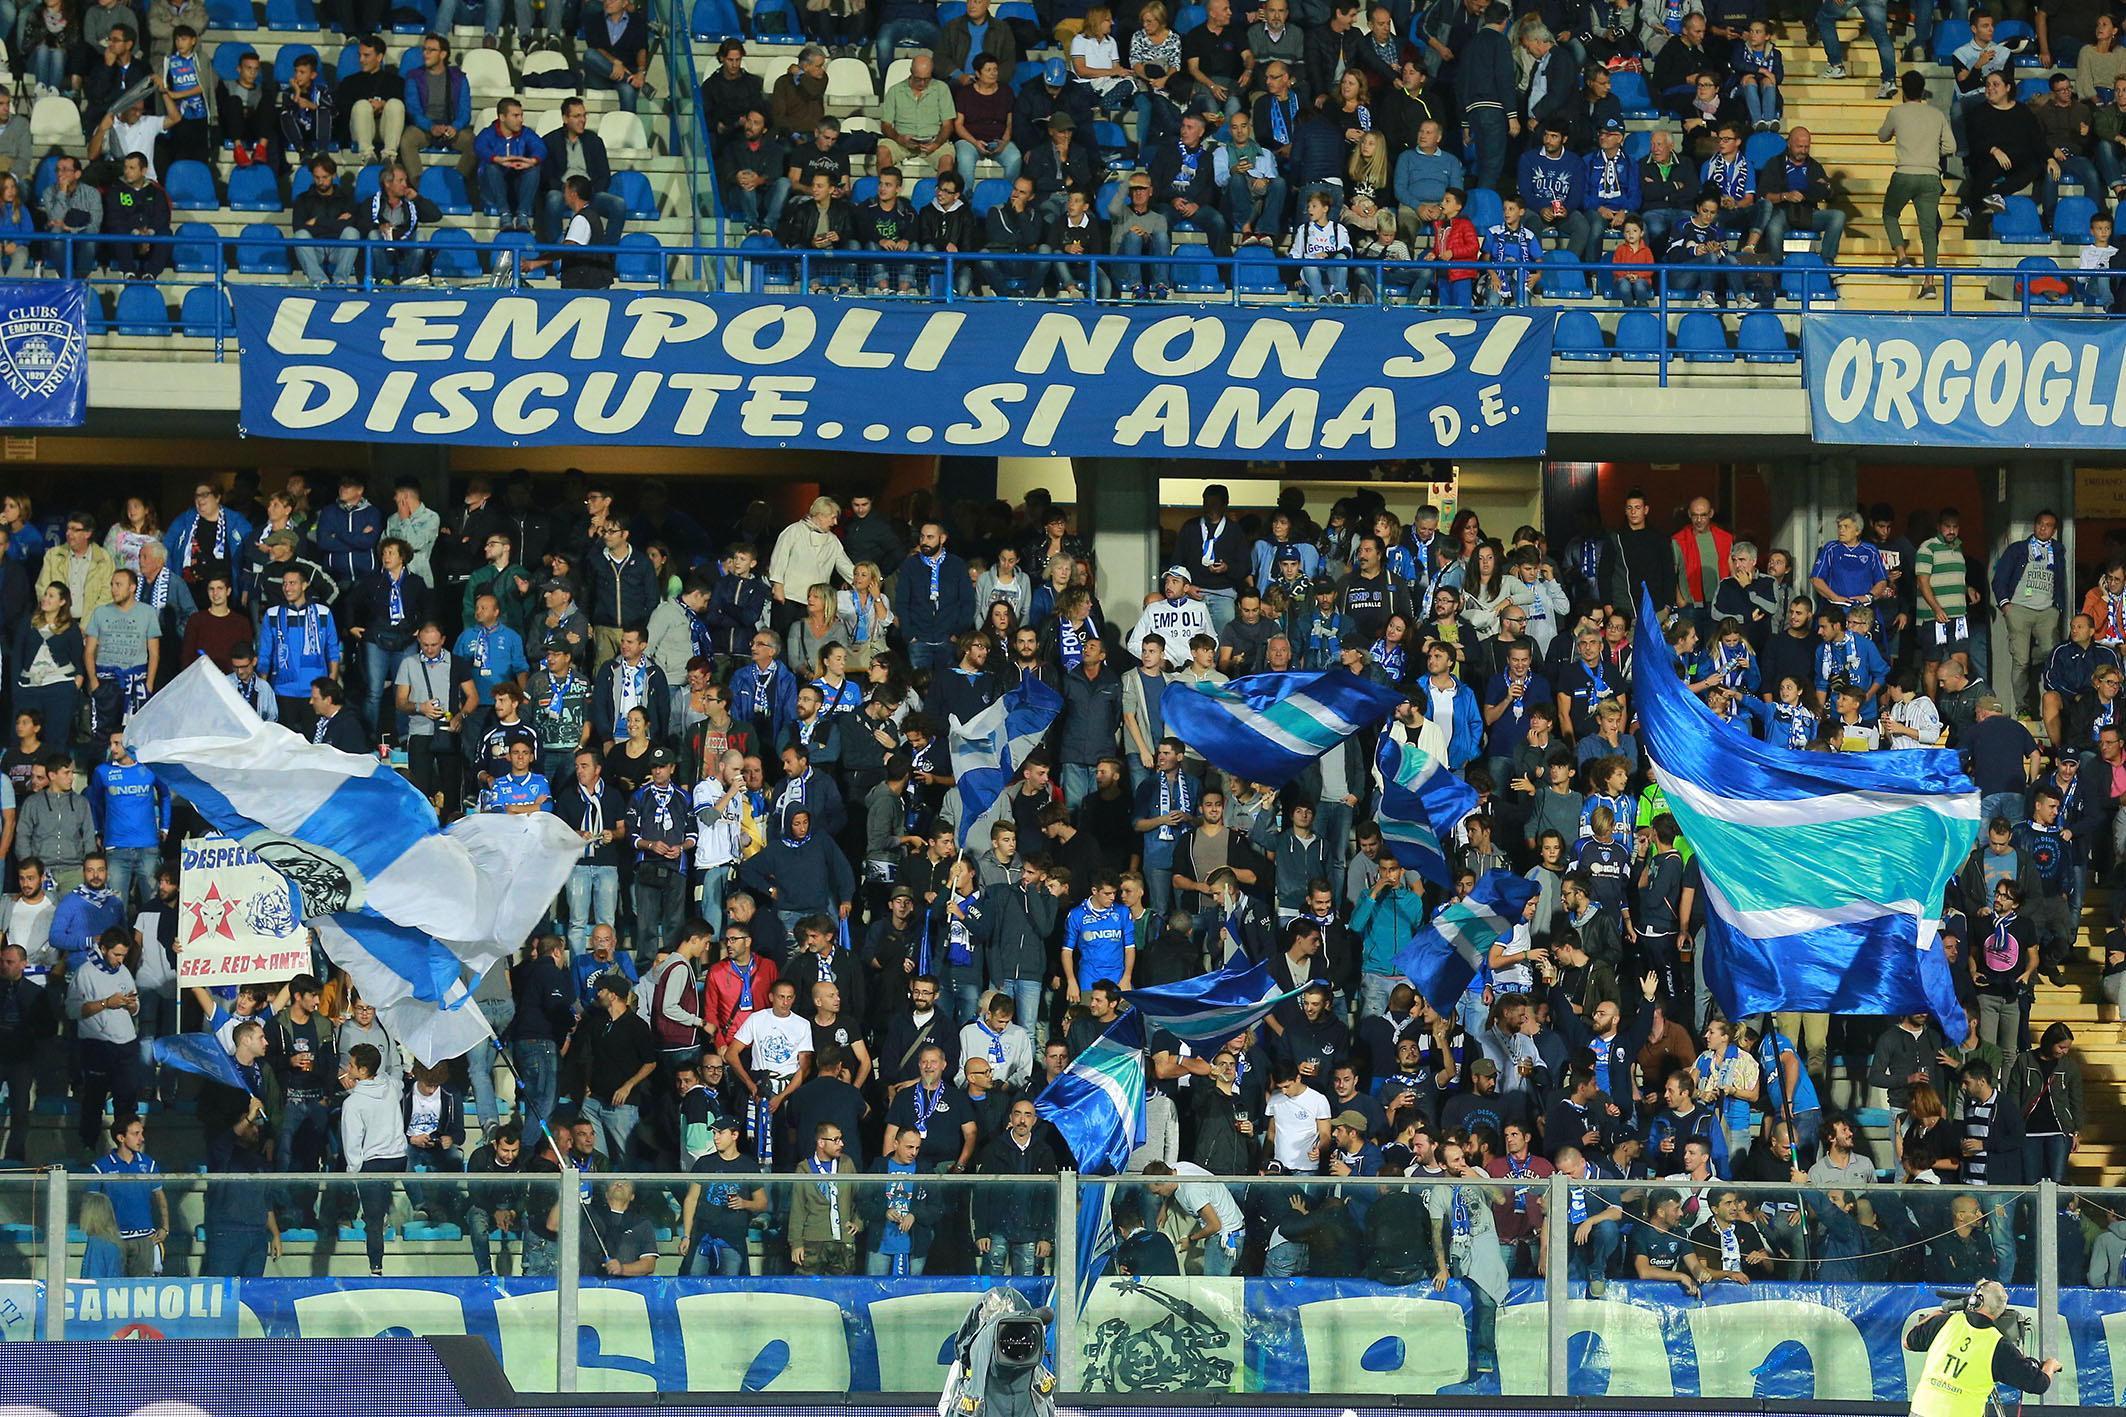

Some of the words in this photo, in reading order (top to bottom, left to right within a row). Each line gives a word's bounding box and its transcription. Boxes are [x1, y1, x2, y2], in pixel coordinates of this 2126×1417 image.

[8, 306, 59, 321] CLUBS
[8, 321, 46, 335] EMPOLI
[267, 296, 967, 373] L'EMPOLI
[1014, 311, 1345, 380] NON
[1383, 315, 1534, 379] SI
[1112, 383, 1398, 450] AMA
[1093, 929, 1122, 940] NGM
[220, 955, 250, 974] RED
[1650, 1258, 1675, 1267] Gensan
[1960, 1336, 1972, 1353] 3
[1943, 1353, 1969, 1379] TV
